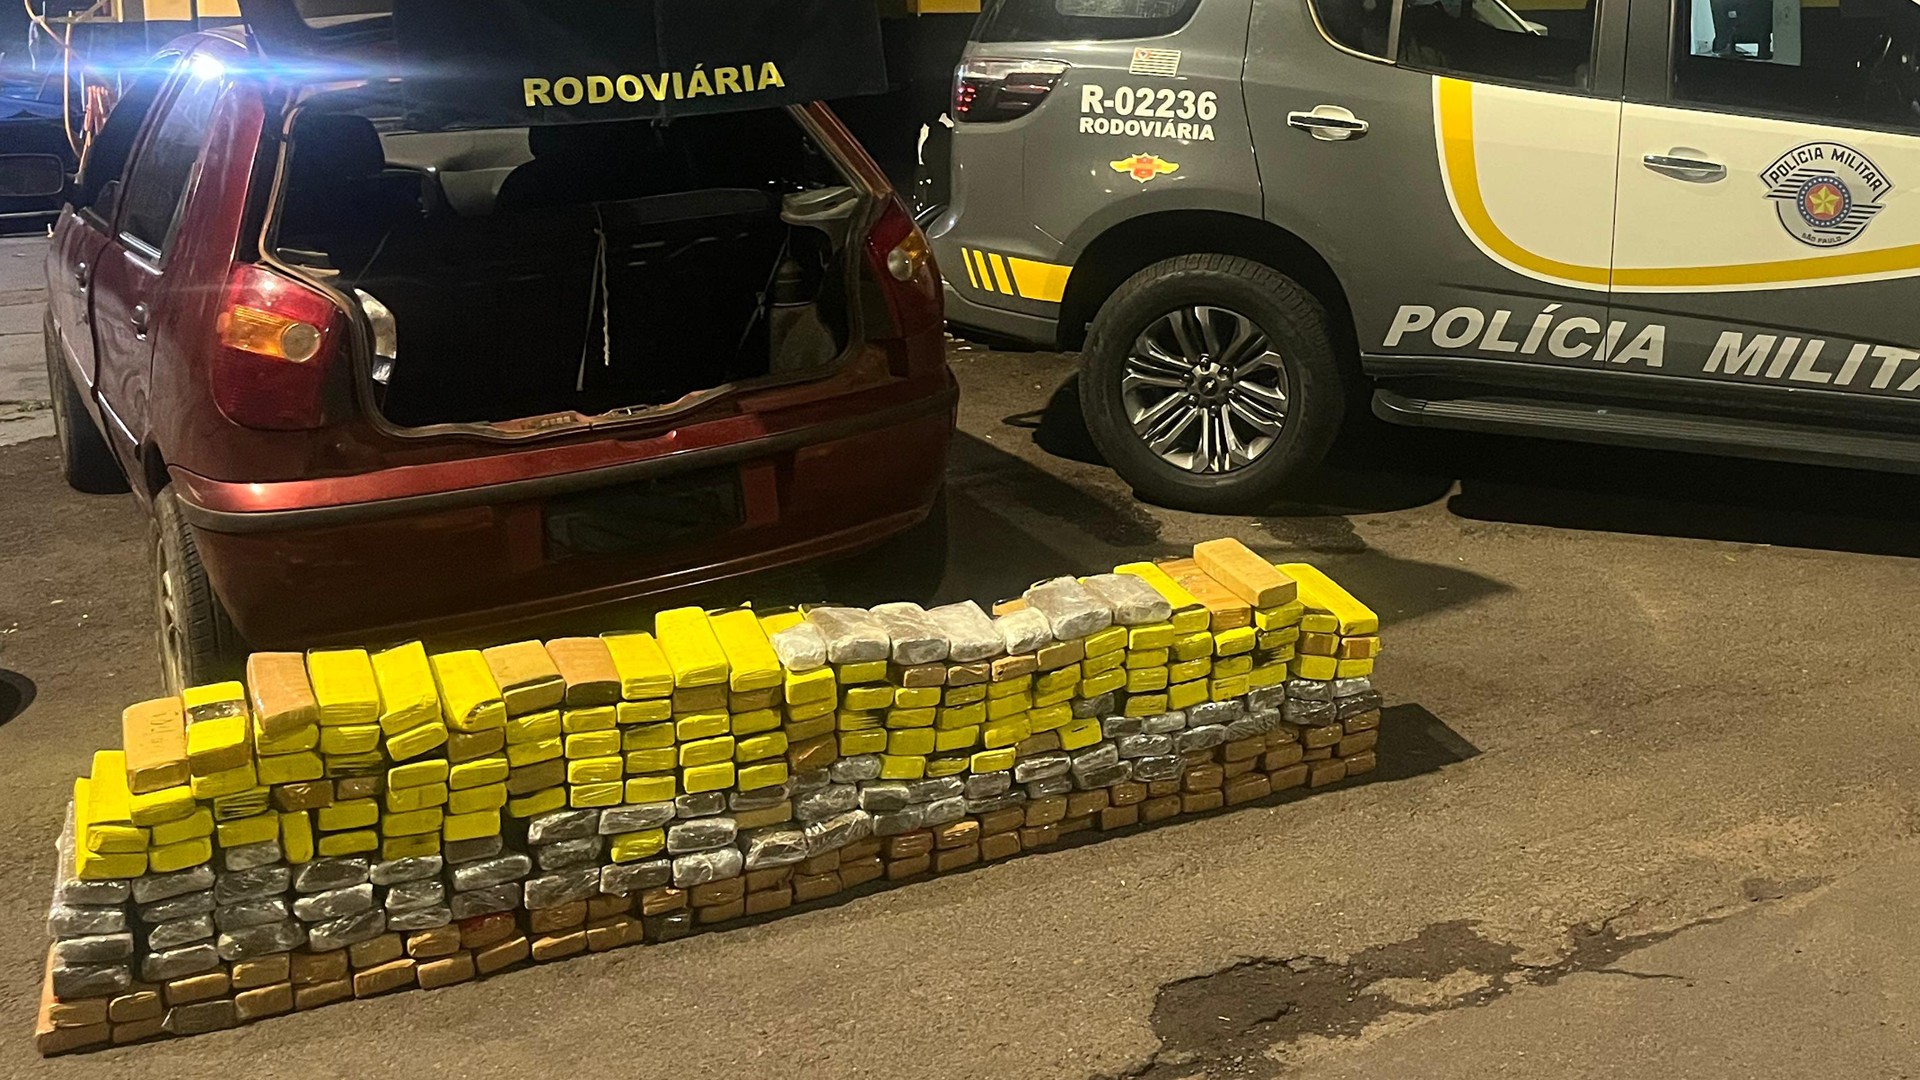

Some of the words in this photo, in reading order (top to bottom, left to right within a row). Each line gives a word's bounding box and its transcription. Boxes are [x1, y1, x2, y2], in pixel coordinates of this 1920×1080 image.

[523, 61, 785, 107] RODOVIÁRIA
[1080, 84, 1218, 121] R-02236
[1079, 117, 1215, 141] RODOVIÁRIA
[1769, 147, 1824, 184] POLÍCIA
[1831, 148, 1883, 192] MILITAR
[1818, 236, 1842, 244] PAULO
[1382, 304, 1666, 367] POLÍCIA
